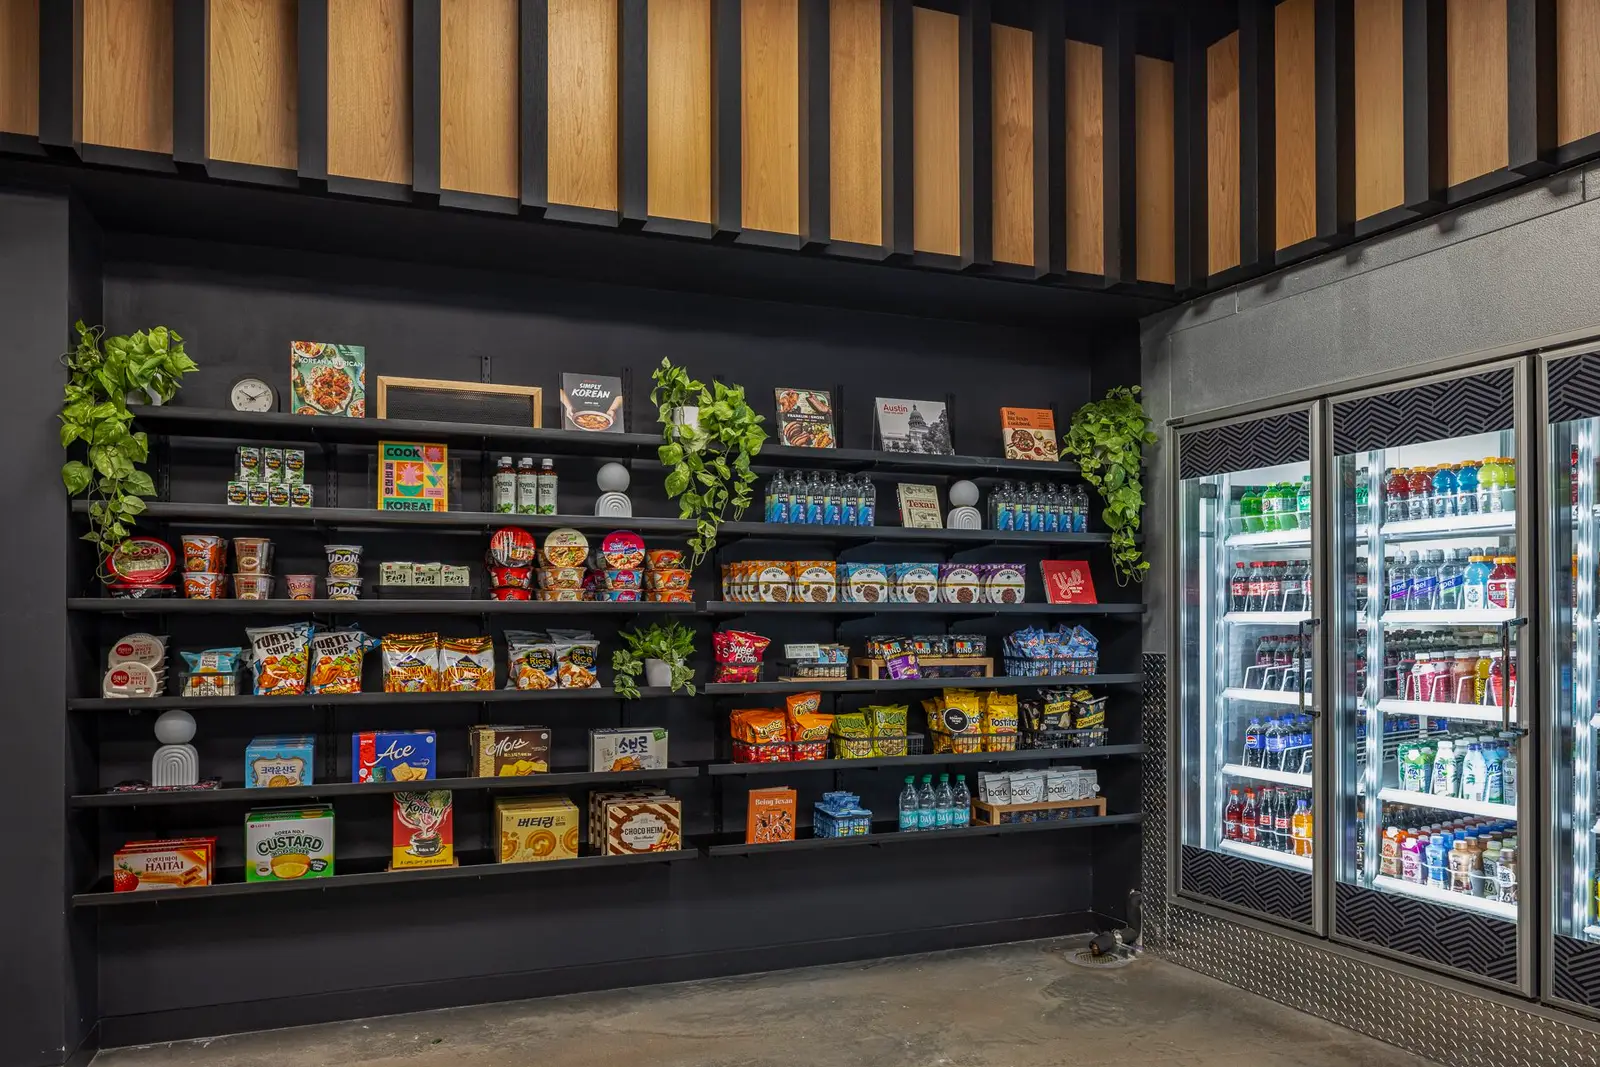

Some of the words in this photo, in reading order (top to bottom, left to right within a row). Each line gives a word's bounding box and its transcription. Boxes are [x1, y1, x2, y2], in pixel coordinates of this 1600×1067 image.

[572, 388, 610, 398] KOREAN
[884, 404, 908, 412] Austin
[386, 448, 420, 458] COOK
[386, 502, 430, 511] KOREA!
[906, 500, 936, 509] Texan
[328, 554, 358, 563] UDON
[328, 586, 357, 595] UDON
[255, 632, 300, 649] TURTLE
[266, 642, 295, 655] CHIPS
[321, 644, 349, 656] CHIPS
[619, 736, 648, 753] 소보로
[364, 740, 416, 766] Ace
[989, 788, 1008, 796] bark
[1012, 788, 1030, 796] bark
[517, 816, 554, 828] 버터링
[624, 827, 645, 836] CHOCO
[258, 835, 322, 853] CUSTARD
[145, 861, 184, 872] HAITAI
